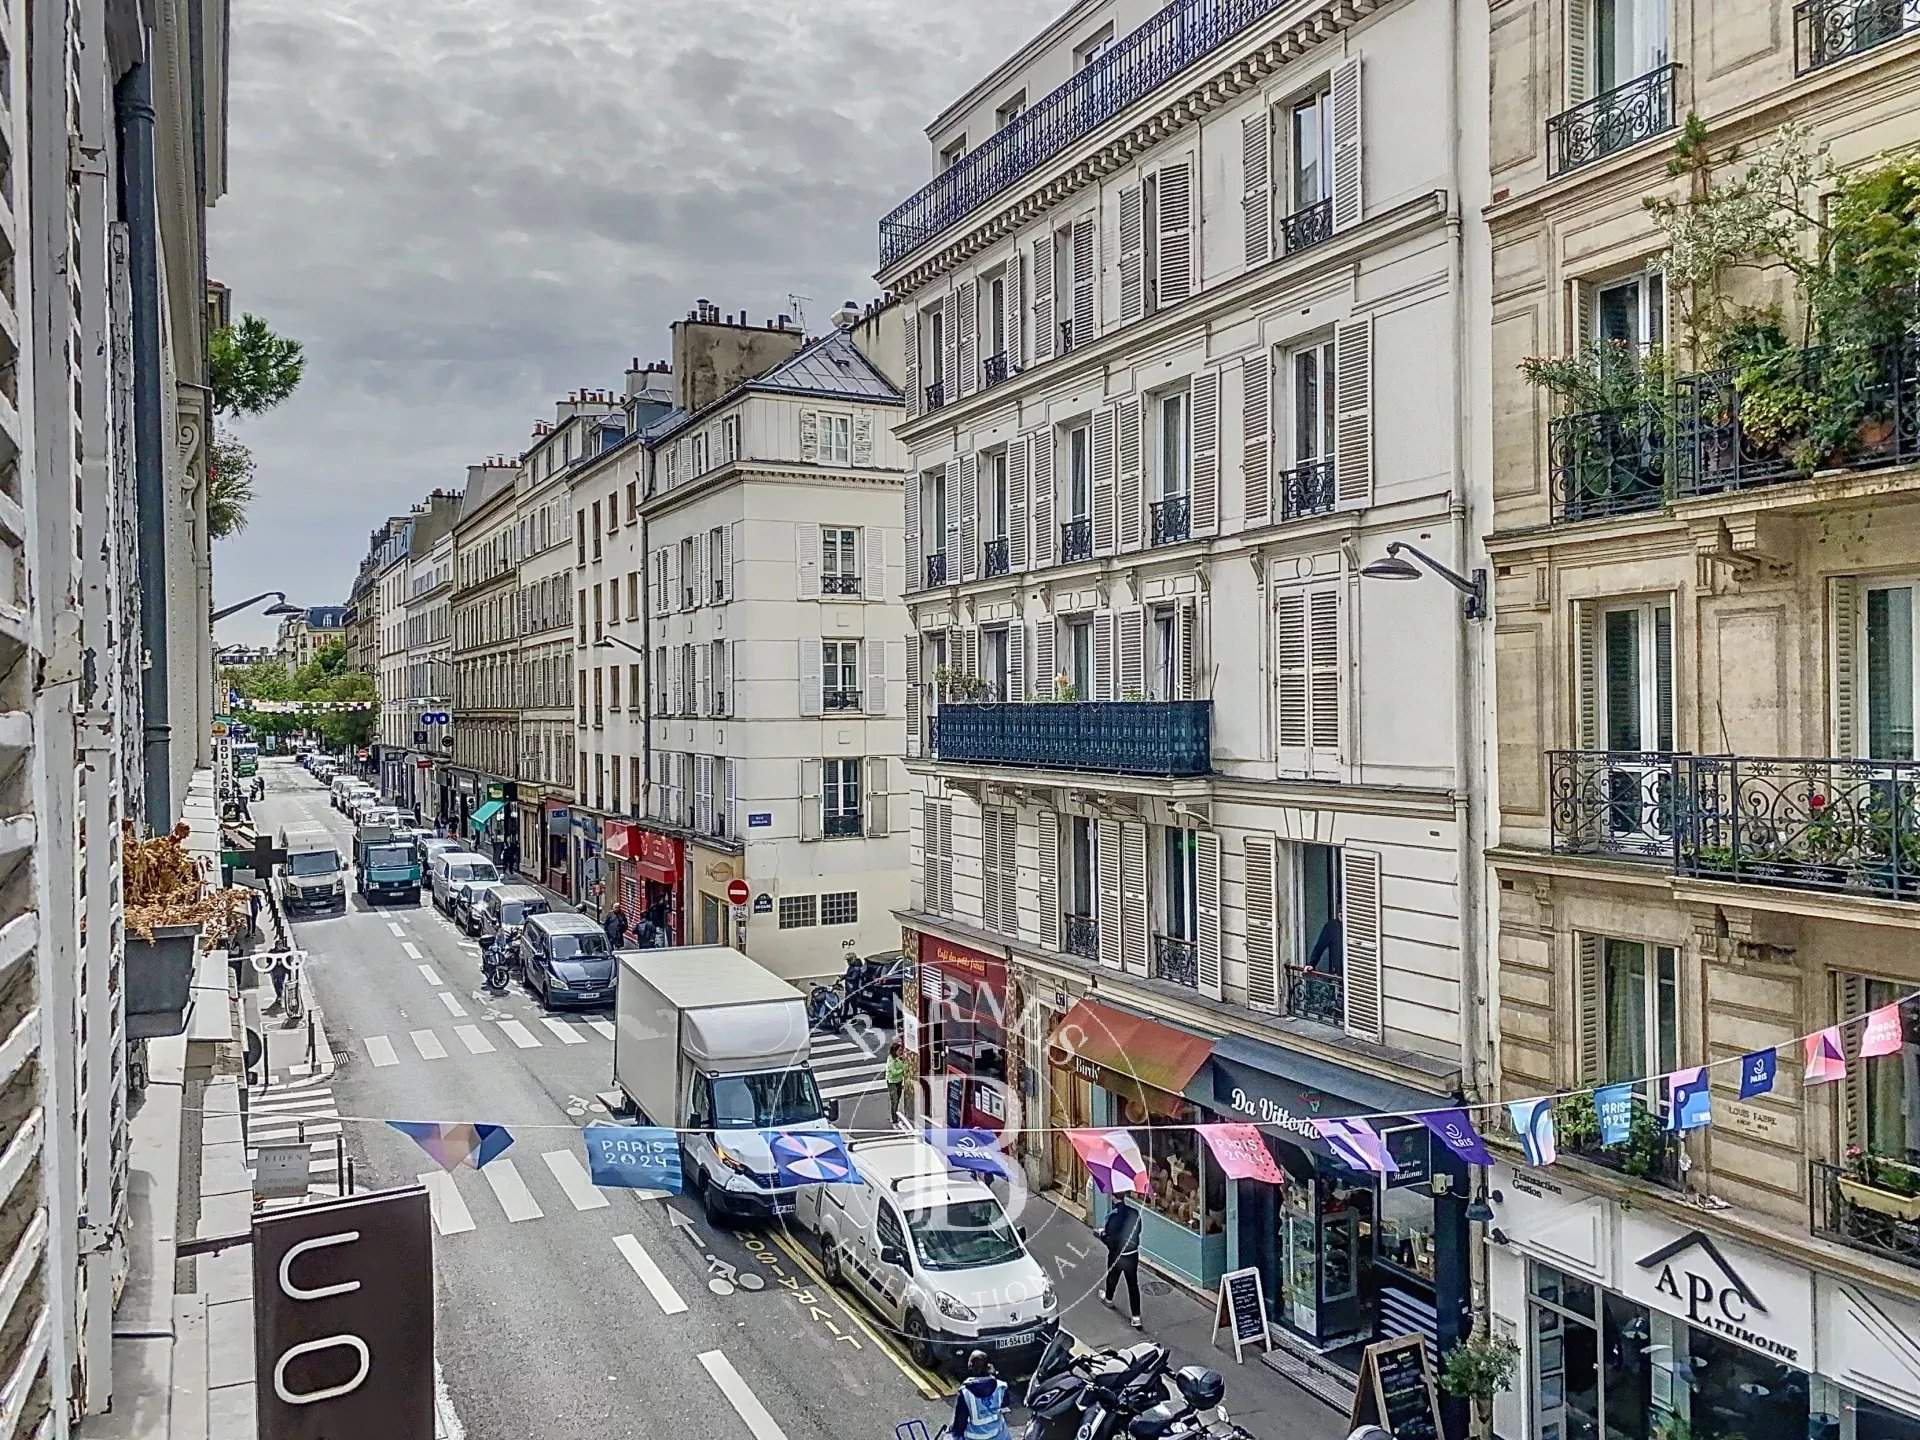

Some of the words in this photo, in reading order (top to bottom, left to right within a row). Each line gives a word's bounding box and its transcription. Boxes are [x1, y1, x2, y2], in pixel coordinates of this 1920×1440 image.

[1232, 1087, 1256, 1115] Da
[601, 1140, 665, 1154] PARIS
[1512, 1167, 1562, 1195] Transaction
[1512, 1179, 1543, 1199] Gestion
[1655, 1264, 1746, 1324] APC
